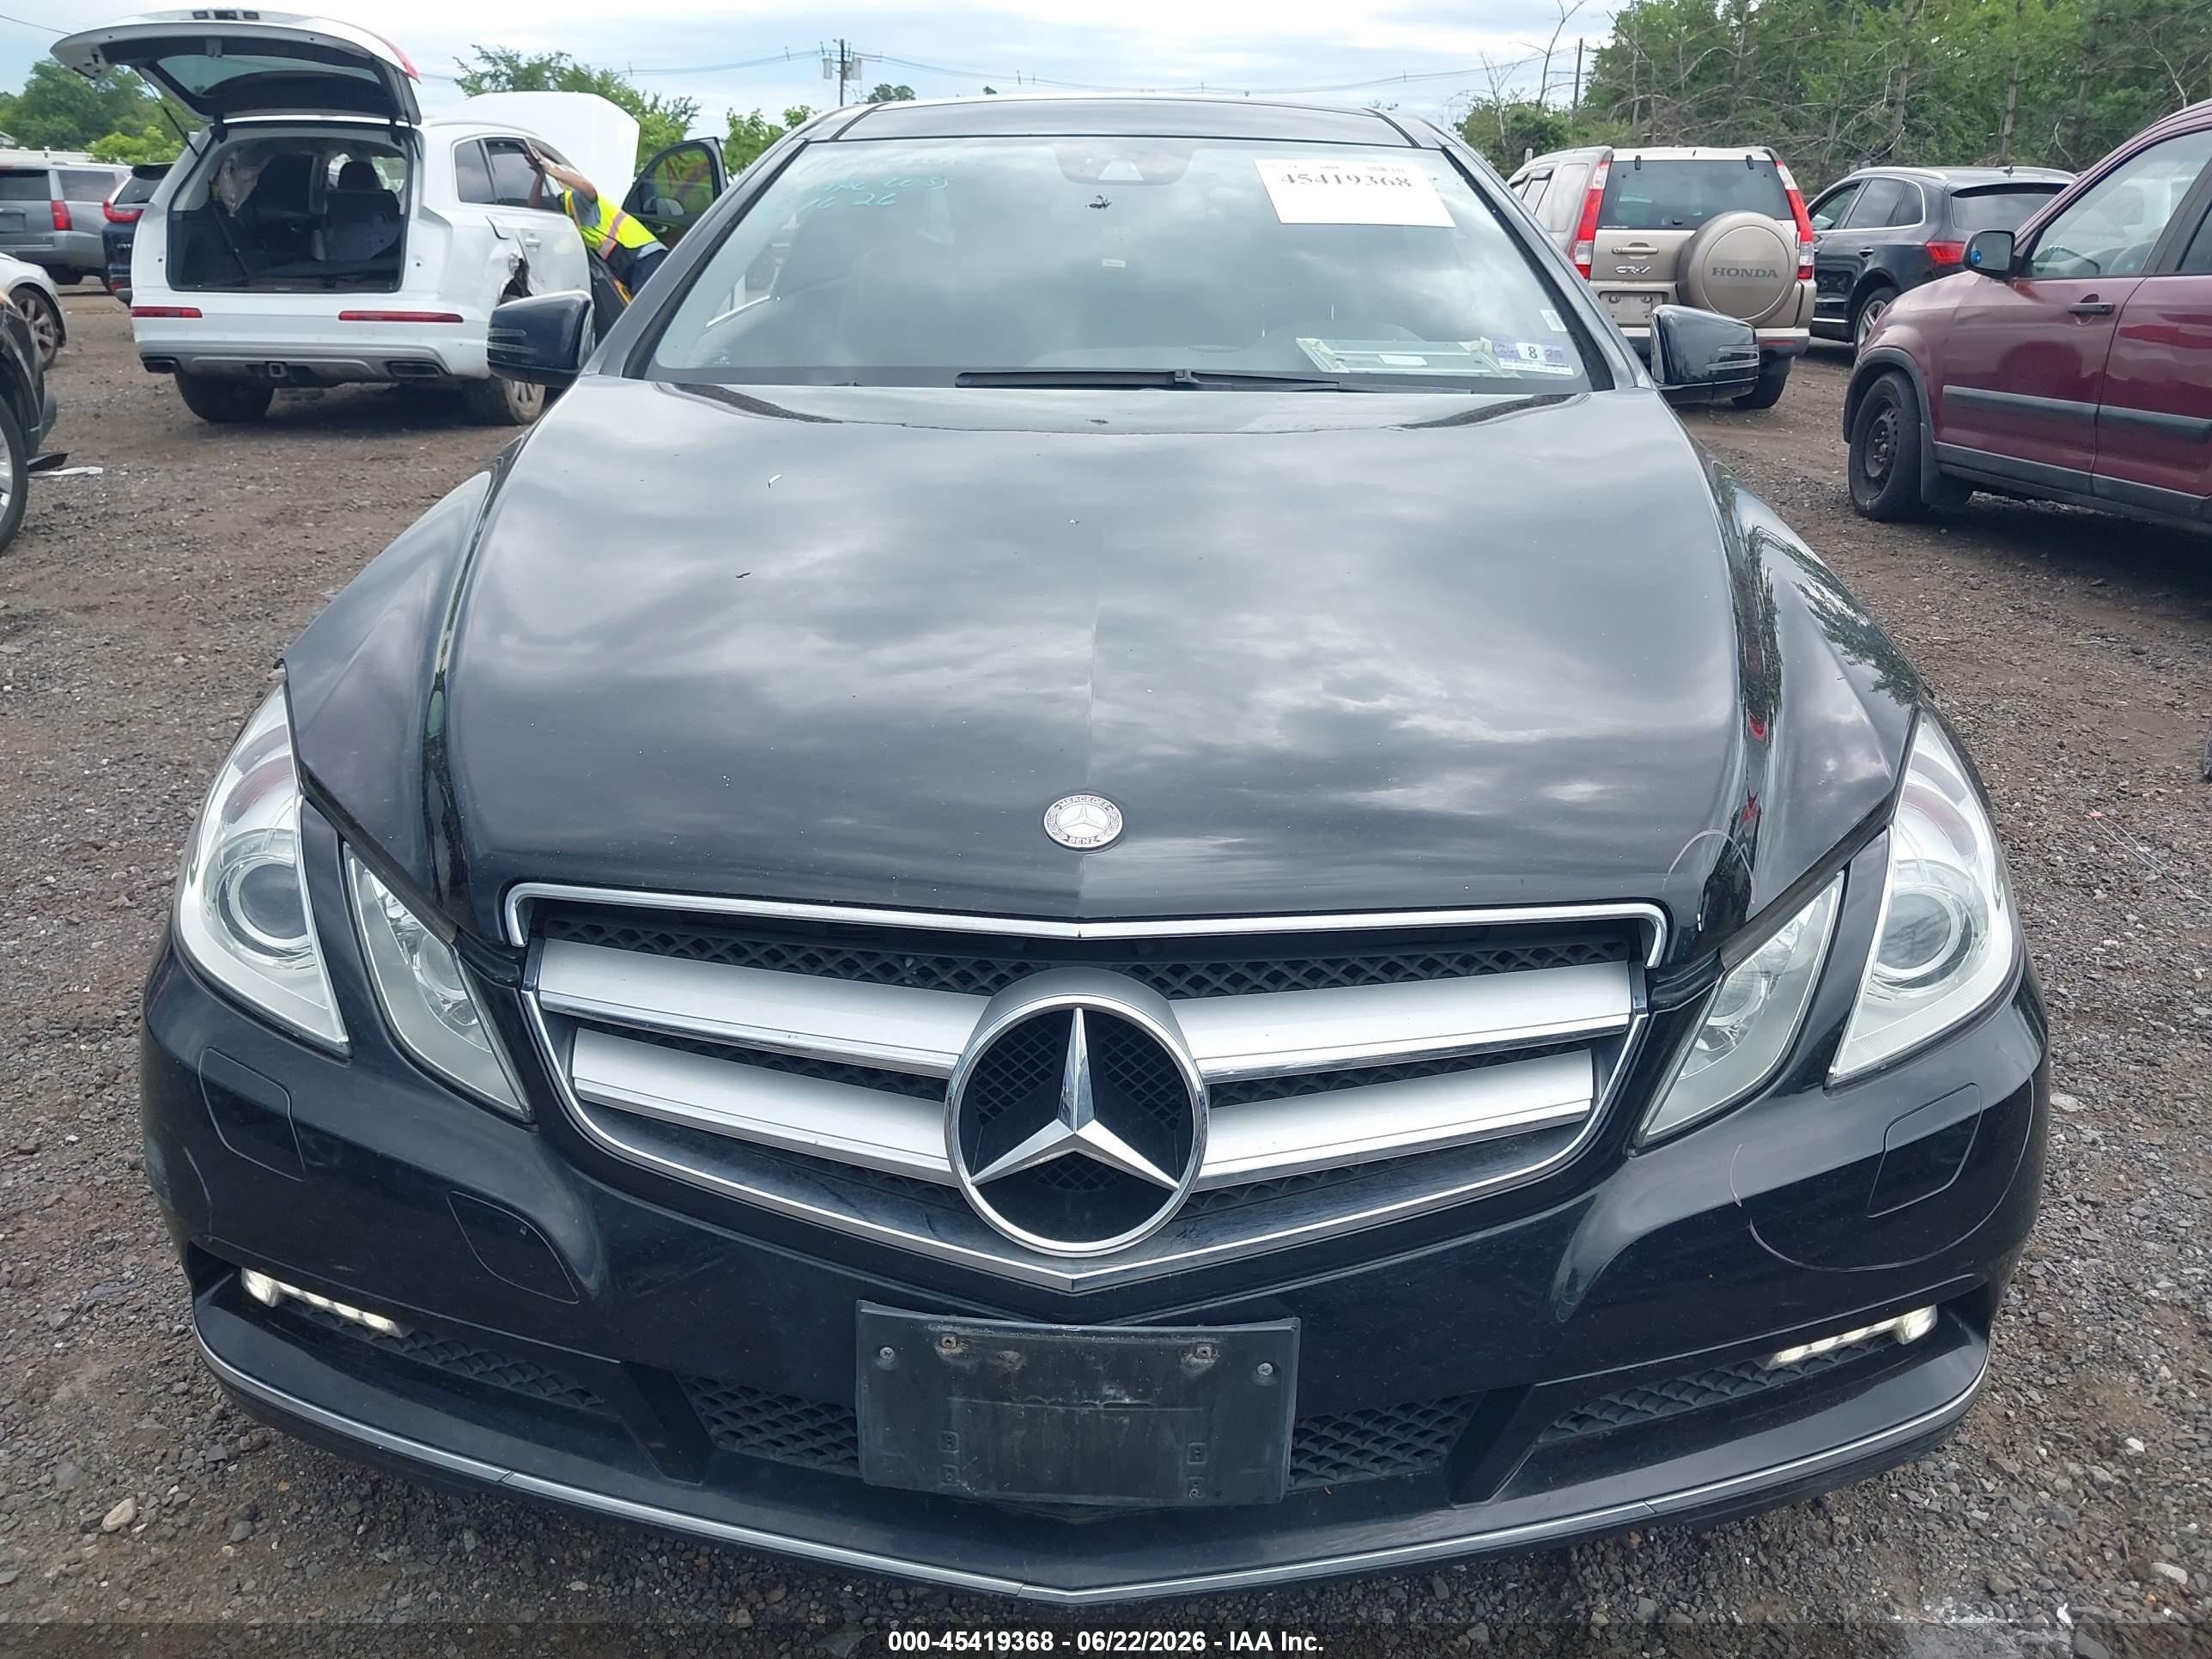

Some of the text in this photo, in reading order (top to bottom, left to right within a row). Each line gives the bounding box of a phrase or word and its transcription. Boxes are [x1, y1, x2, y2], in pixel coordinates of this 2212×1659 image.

[1281, 173, 1412, 187] 45419368
[1711, 266, 1779, 279] HONDA
[1528, 346, 1538, 359] 8
[1057, 795, 1111, 809] MERCEDES
[1068, 836, 1097, 846] BENZ
